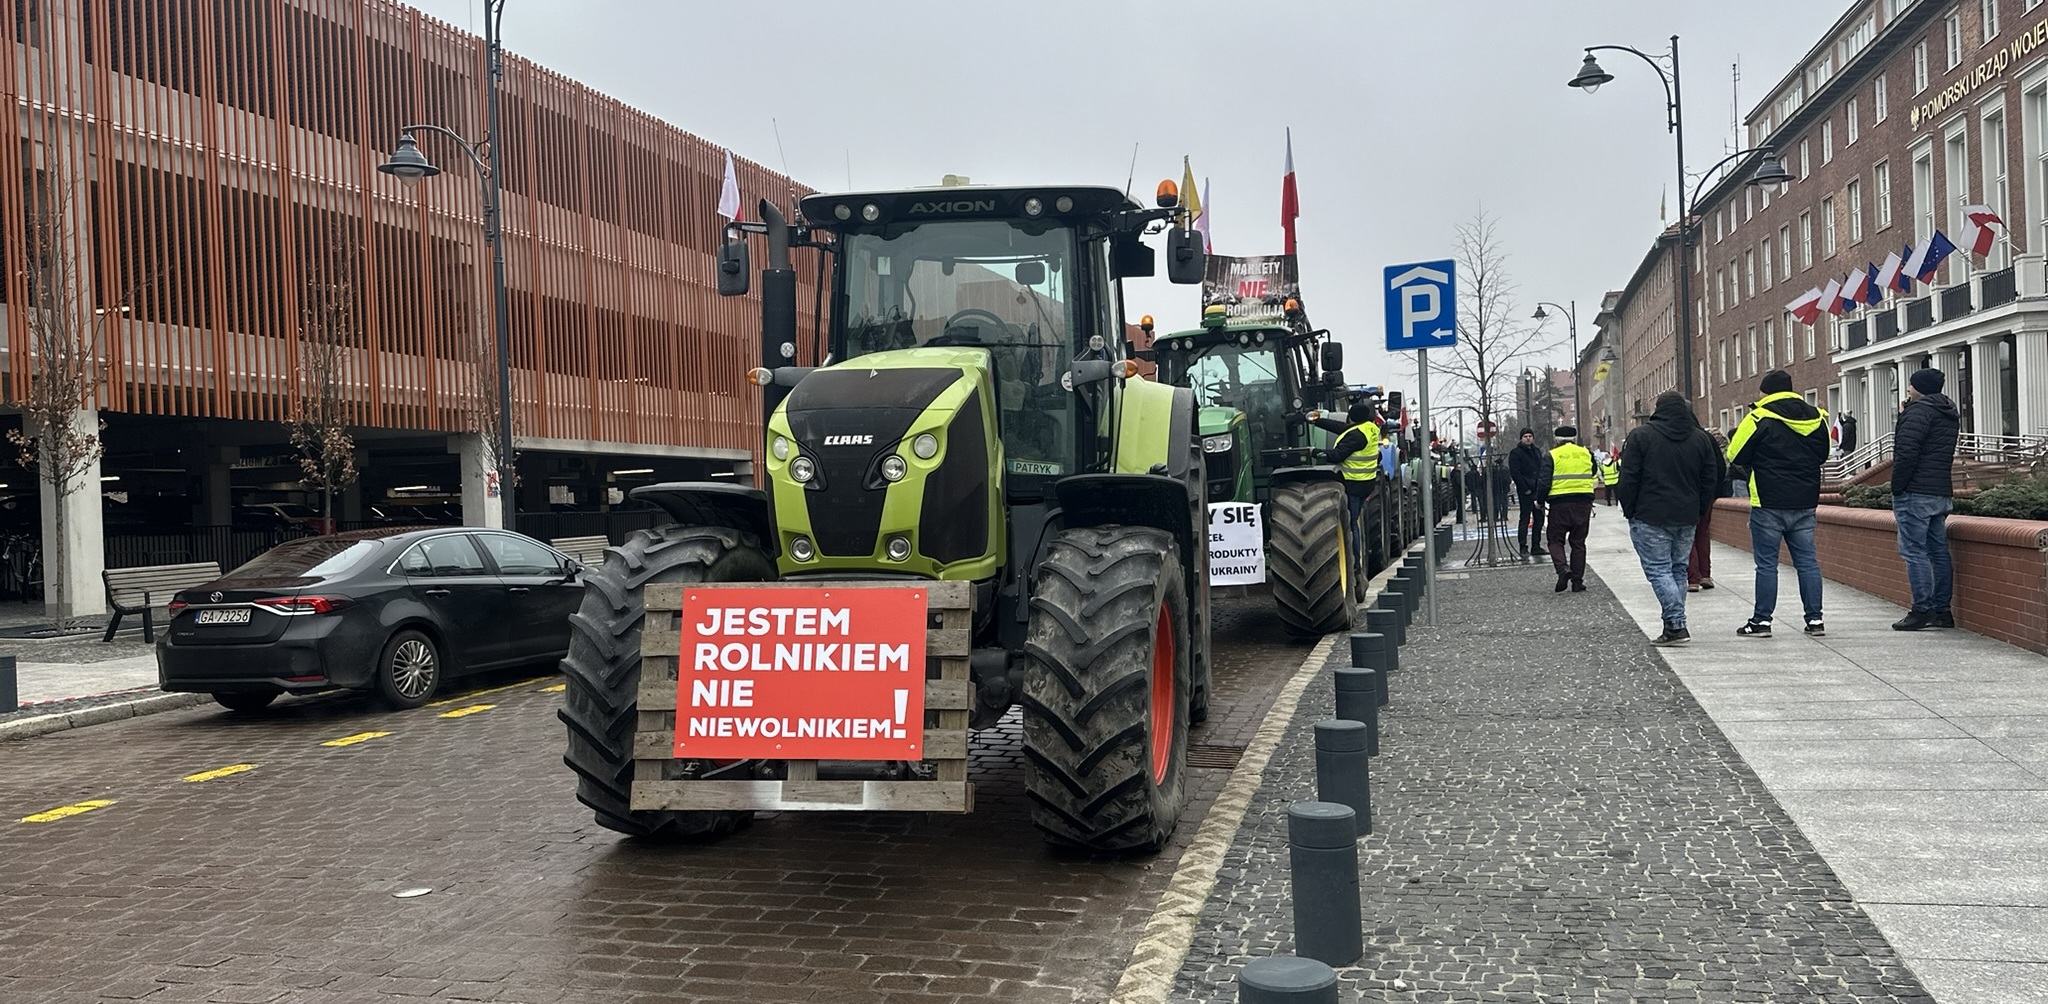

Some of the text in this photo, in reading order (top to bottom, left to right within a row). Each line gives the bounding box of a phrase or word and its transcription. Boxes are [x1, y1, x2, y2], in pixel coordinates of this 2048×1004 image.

[1921, 19, 2048, 124] POMORSKI URZĄD WOJE
[908, 200, 995, 214] AXION
[1230, 261, 1280, 275] MARKETY
[1237, 280, 1269, 298] NIE
[1226, 304, 1286, 319] RODUKUJĄ
[1401, 283, 1440, 338] P
[824, 434, 873, 446] CLAAS
[1015, 463, 1052, 474] PATRYK
[1223, 506, 1255, 528] SIĘ
[1209, 548, 1257, 559] RODUKTY
[1211, 565, 1257, 576] UKRAINY
[201, 610, 248, 623] GA 73256
[696, 607, 850, 636] JESTEM
[694, 643, 909, 672] ROLNIKIEM
[691, 679, 754, 707] NIE
[689, 689, 909, 739] NIEWOLNIKIEM!
